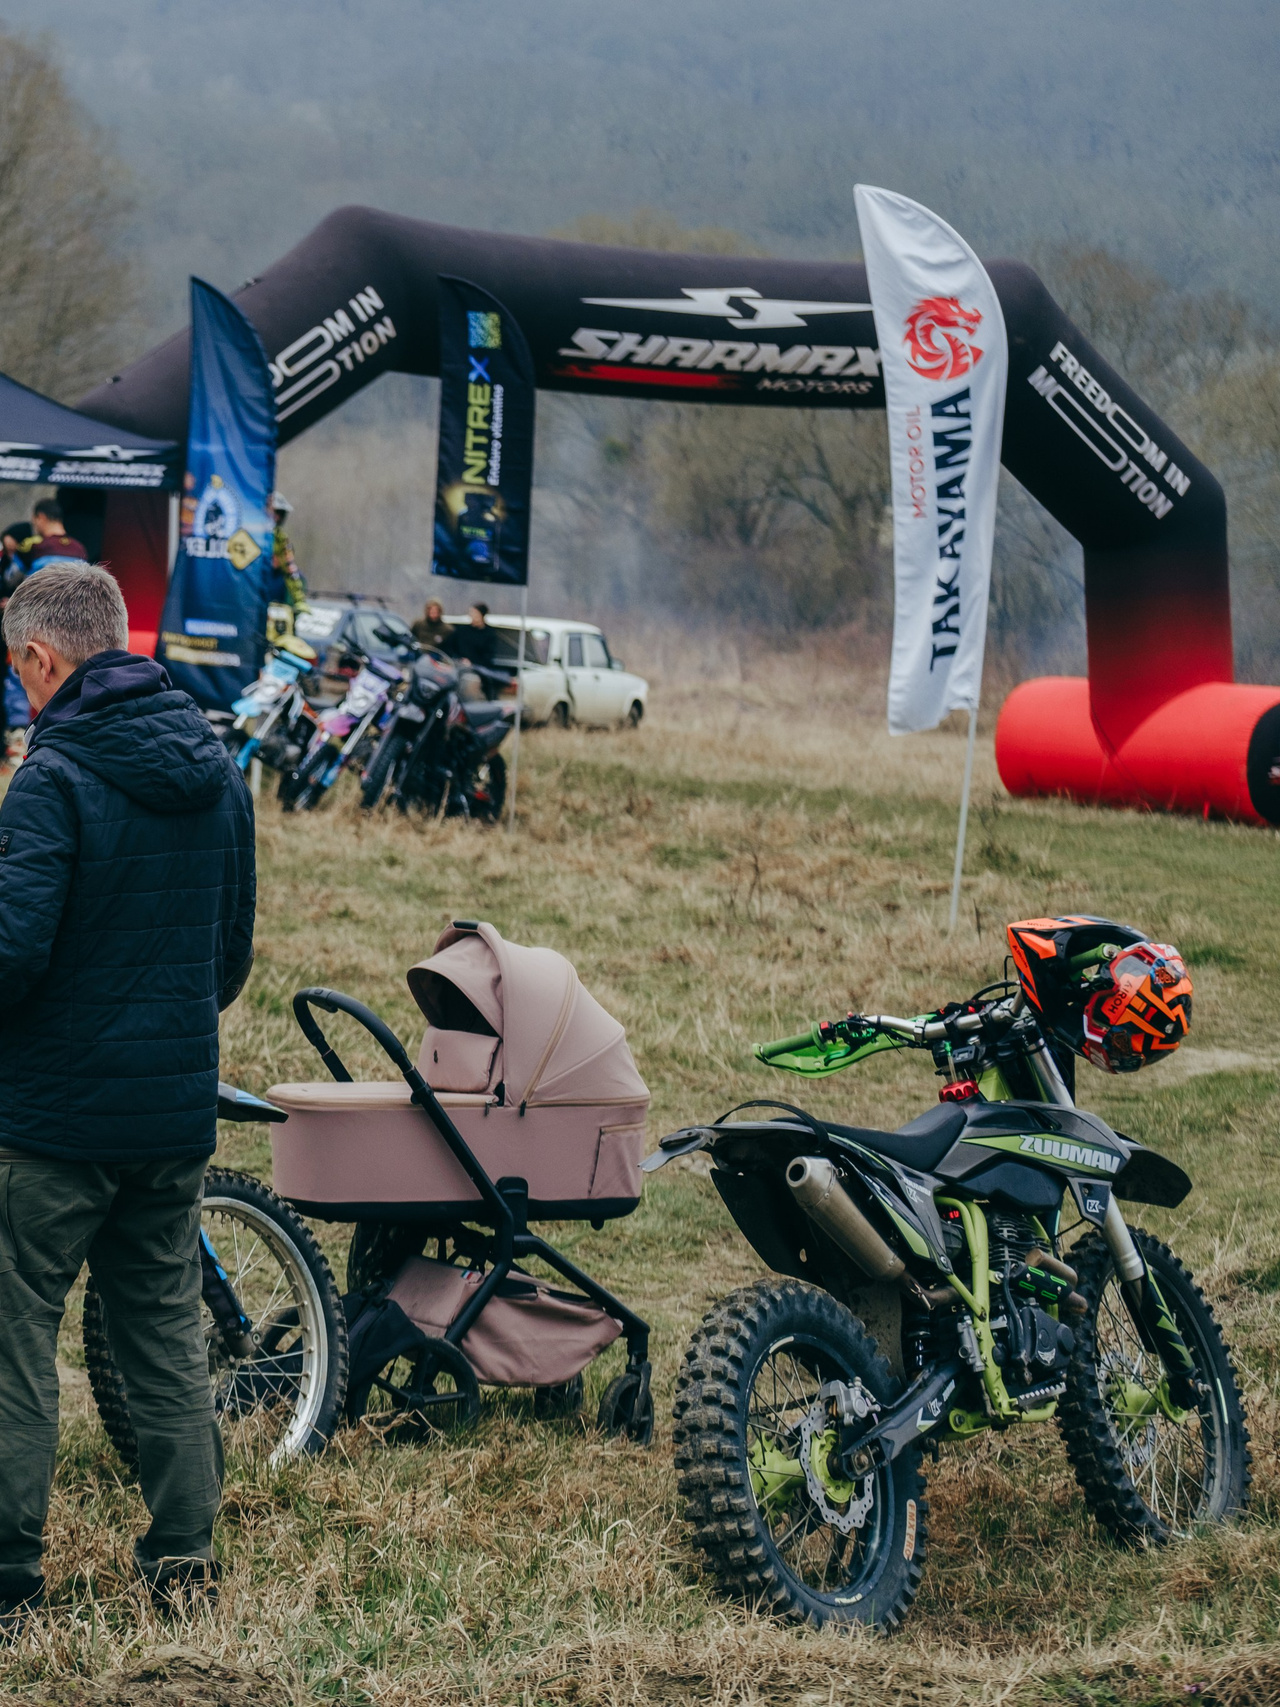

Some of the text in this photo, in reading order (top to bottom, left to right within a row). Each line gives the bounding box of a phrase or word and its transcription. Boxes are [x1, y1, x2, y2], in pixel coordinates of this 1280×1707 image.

[348, 285, 384, 323] IN
[558, 327, 882, 377] SHARMAX
[756, 377, 873, 395] MOTORS
[462, 354, 491, 486] NITREX
[1026, 364, 1175, 520] MOTION
[1049, 340, 1192, 498] FREEDOM IN
[487, 438, 502, 487] Enduro
[906, 404, 927, 519] MOTOR OIL
[929, 385, 972, 675] TAKAYAMA
[1107, 980, 1133, 1015] AIROH
[1019, 1134, 1121, 1175] ZUUMAV
